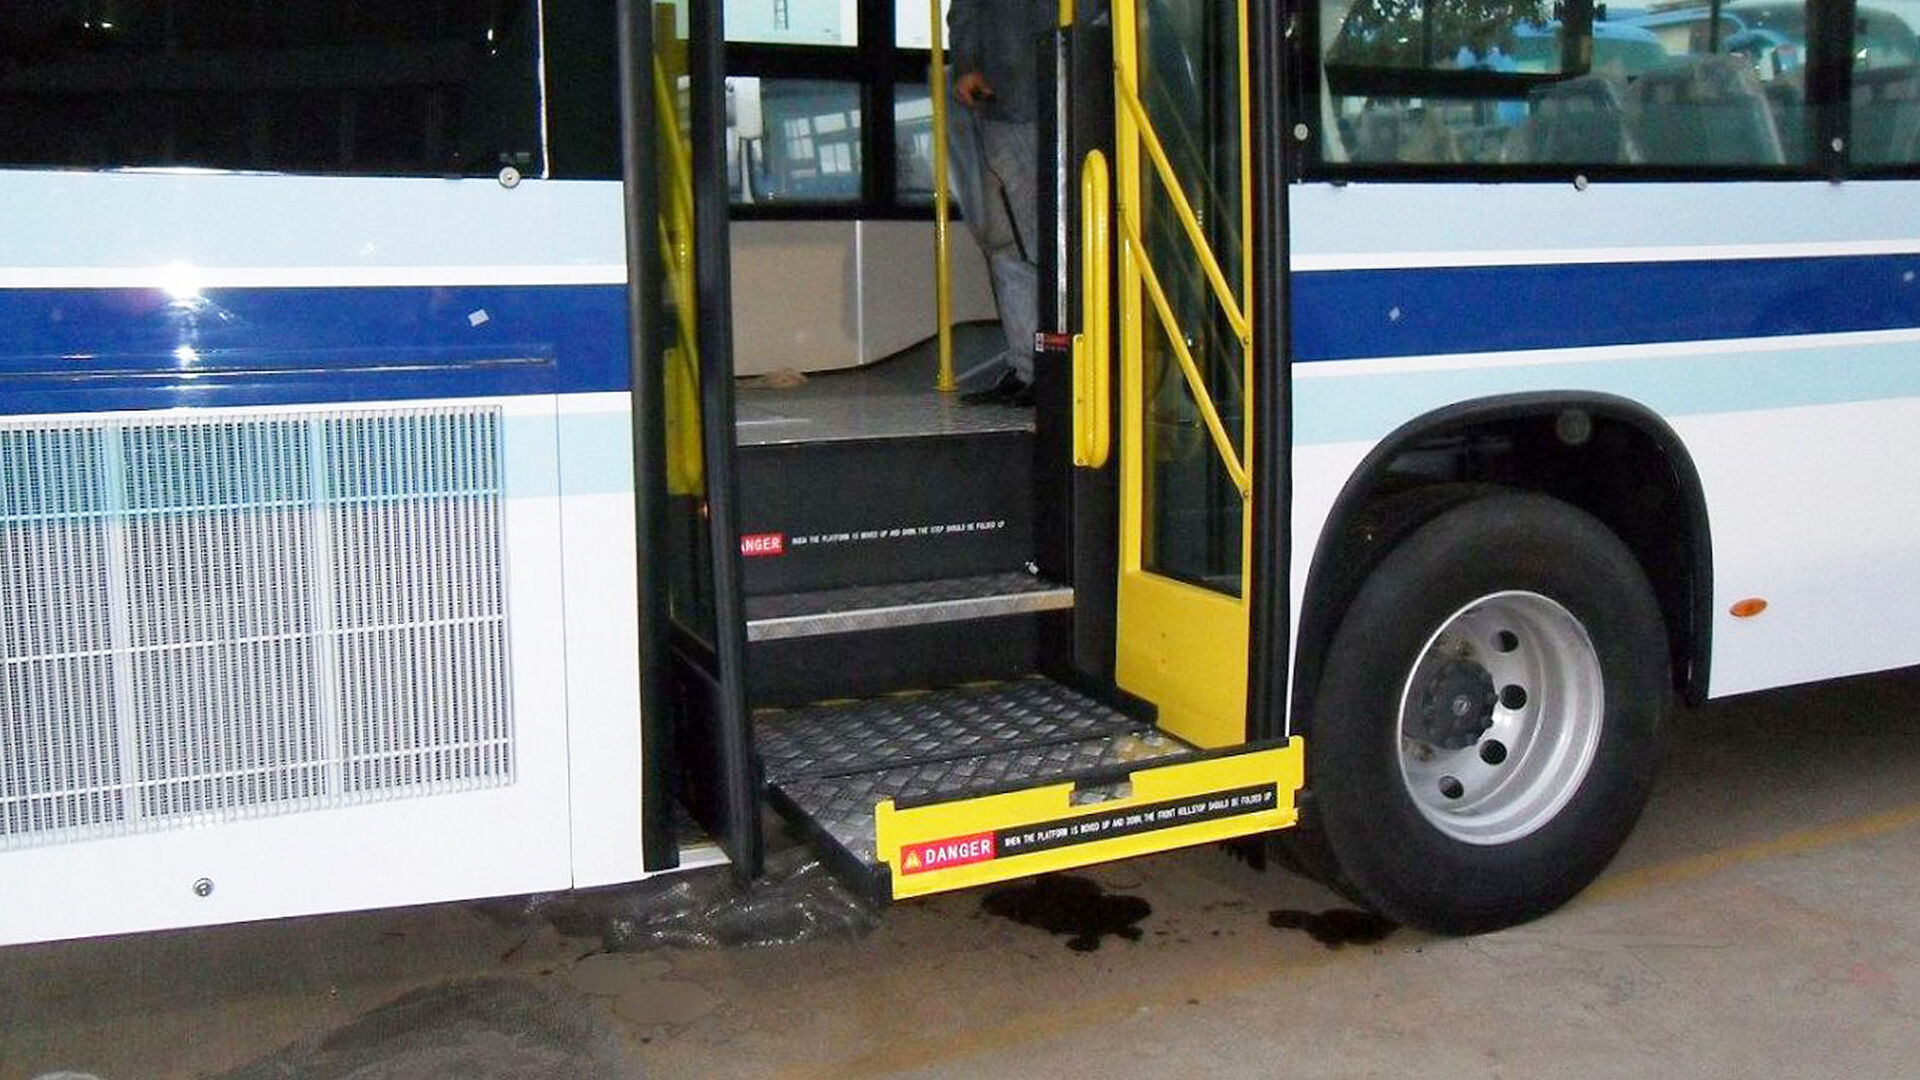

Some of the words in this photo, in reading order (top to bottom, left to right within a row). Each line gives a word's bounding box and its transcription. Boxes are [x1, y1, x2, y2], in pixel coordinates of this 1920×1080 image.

[741, 537, 781, 552] NGER
[925, 839, 990, 865] DANGER
[1024, 833, 1035, 843] THE
[1037, 828, 1068, 841] PLATFORM
[1070, 825, 1078, 835] IS
[1101, 819, 1110, 830] UP
[1112, 817, 1125, 828] AND
[1157, 808, 1176, 820] FRONT
[1208, 799, 1229, 811] SHOULD
[1240, 793, 1262, 805] FOLDED
